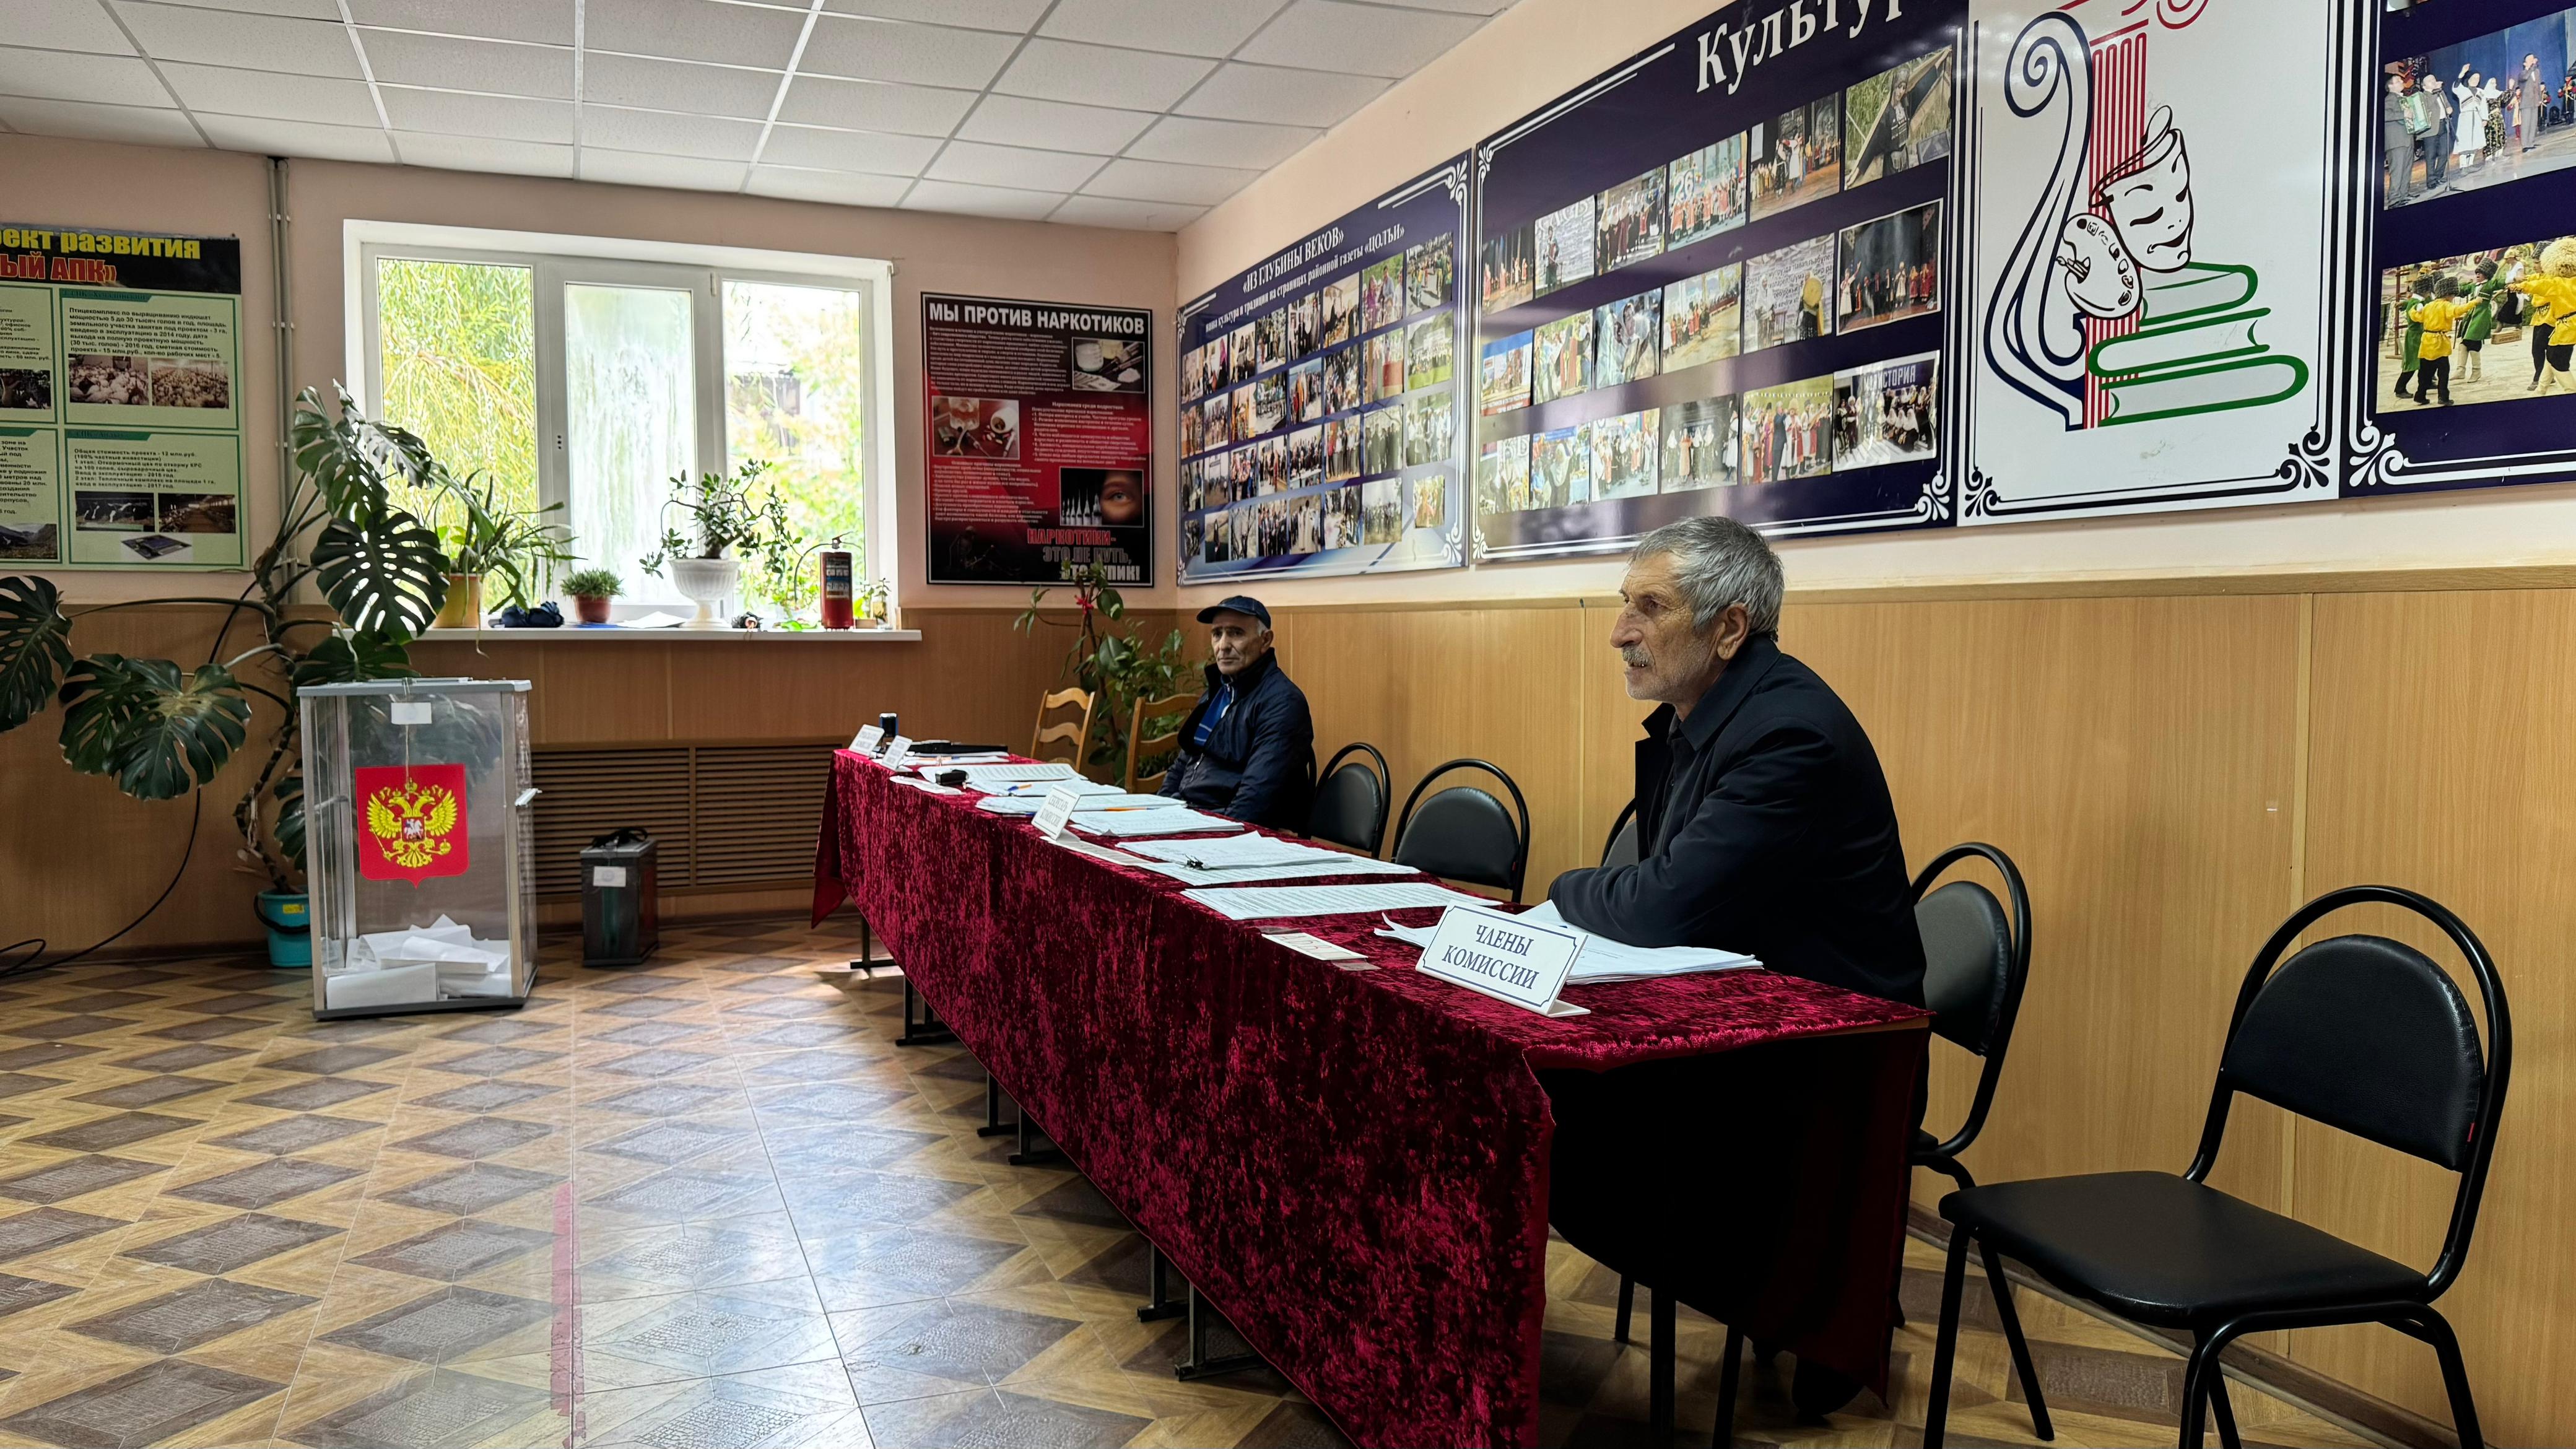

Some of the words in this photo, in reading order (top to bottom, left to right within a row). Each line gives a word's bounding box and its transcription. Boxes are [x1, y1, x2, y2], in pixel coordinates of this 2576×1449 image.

[1697, 0, 1902, 95] Культу
[0, 228, 54, 248] ект
[60, 231, 200, 259] развития
[50, 257, 116, 283] АПК»
[1243, 270, 1257, 294] «ИЗ
[1259, 245, 1303, 286] ГЛУБИНЫ
[1305, 227, 1344, 262] ВЕКОВ»
[1218, 308, 1239, 328] культура
[1269, 289, 1276, 301] на
[1277, 272, 1307, 298] страницах
[1308, 254, 1338, 286] районной
[1340, 245, 1364, 266] газеты
[929, 302, 959, 323] МЫ
[965, 305, 1032, 328] ПРОТИВ
[1037, 310, 1145, 334] НАРКОТИКОВ
[1073, 547, 1090, 563] НЕ
[1476, 925, 1534, 956] ЧЛЕНЫ
[1442, 944, 1539, 990] КОМИССИИ
